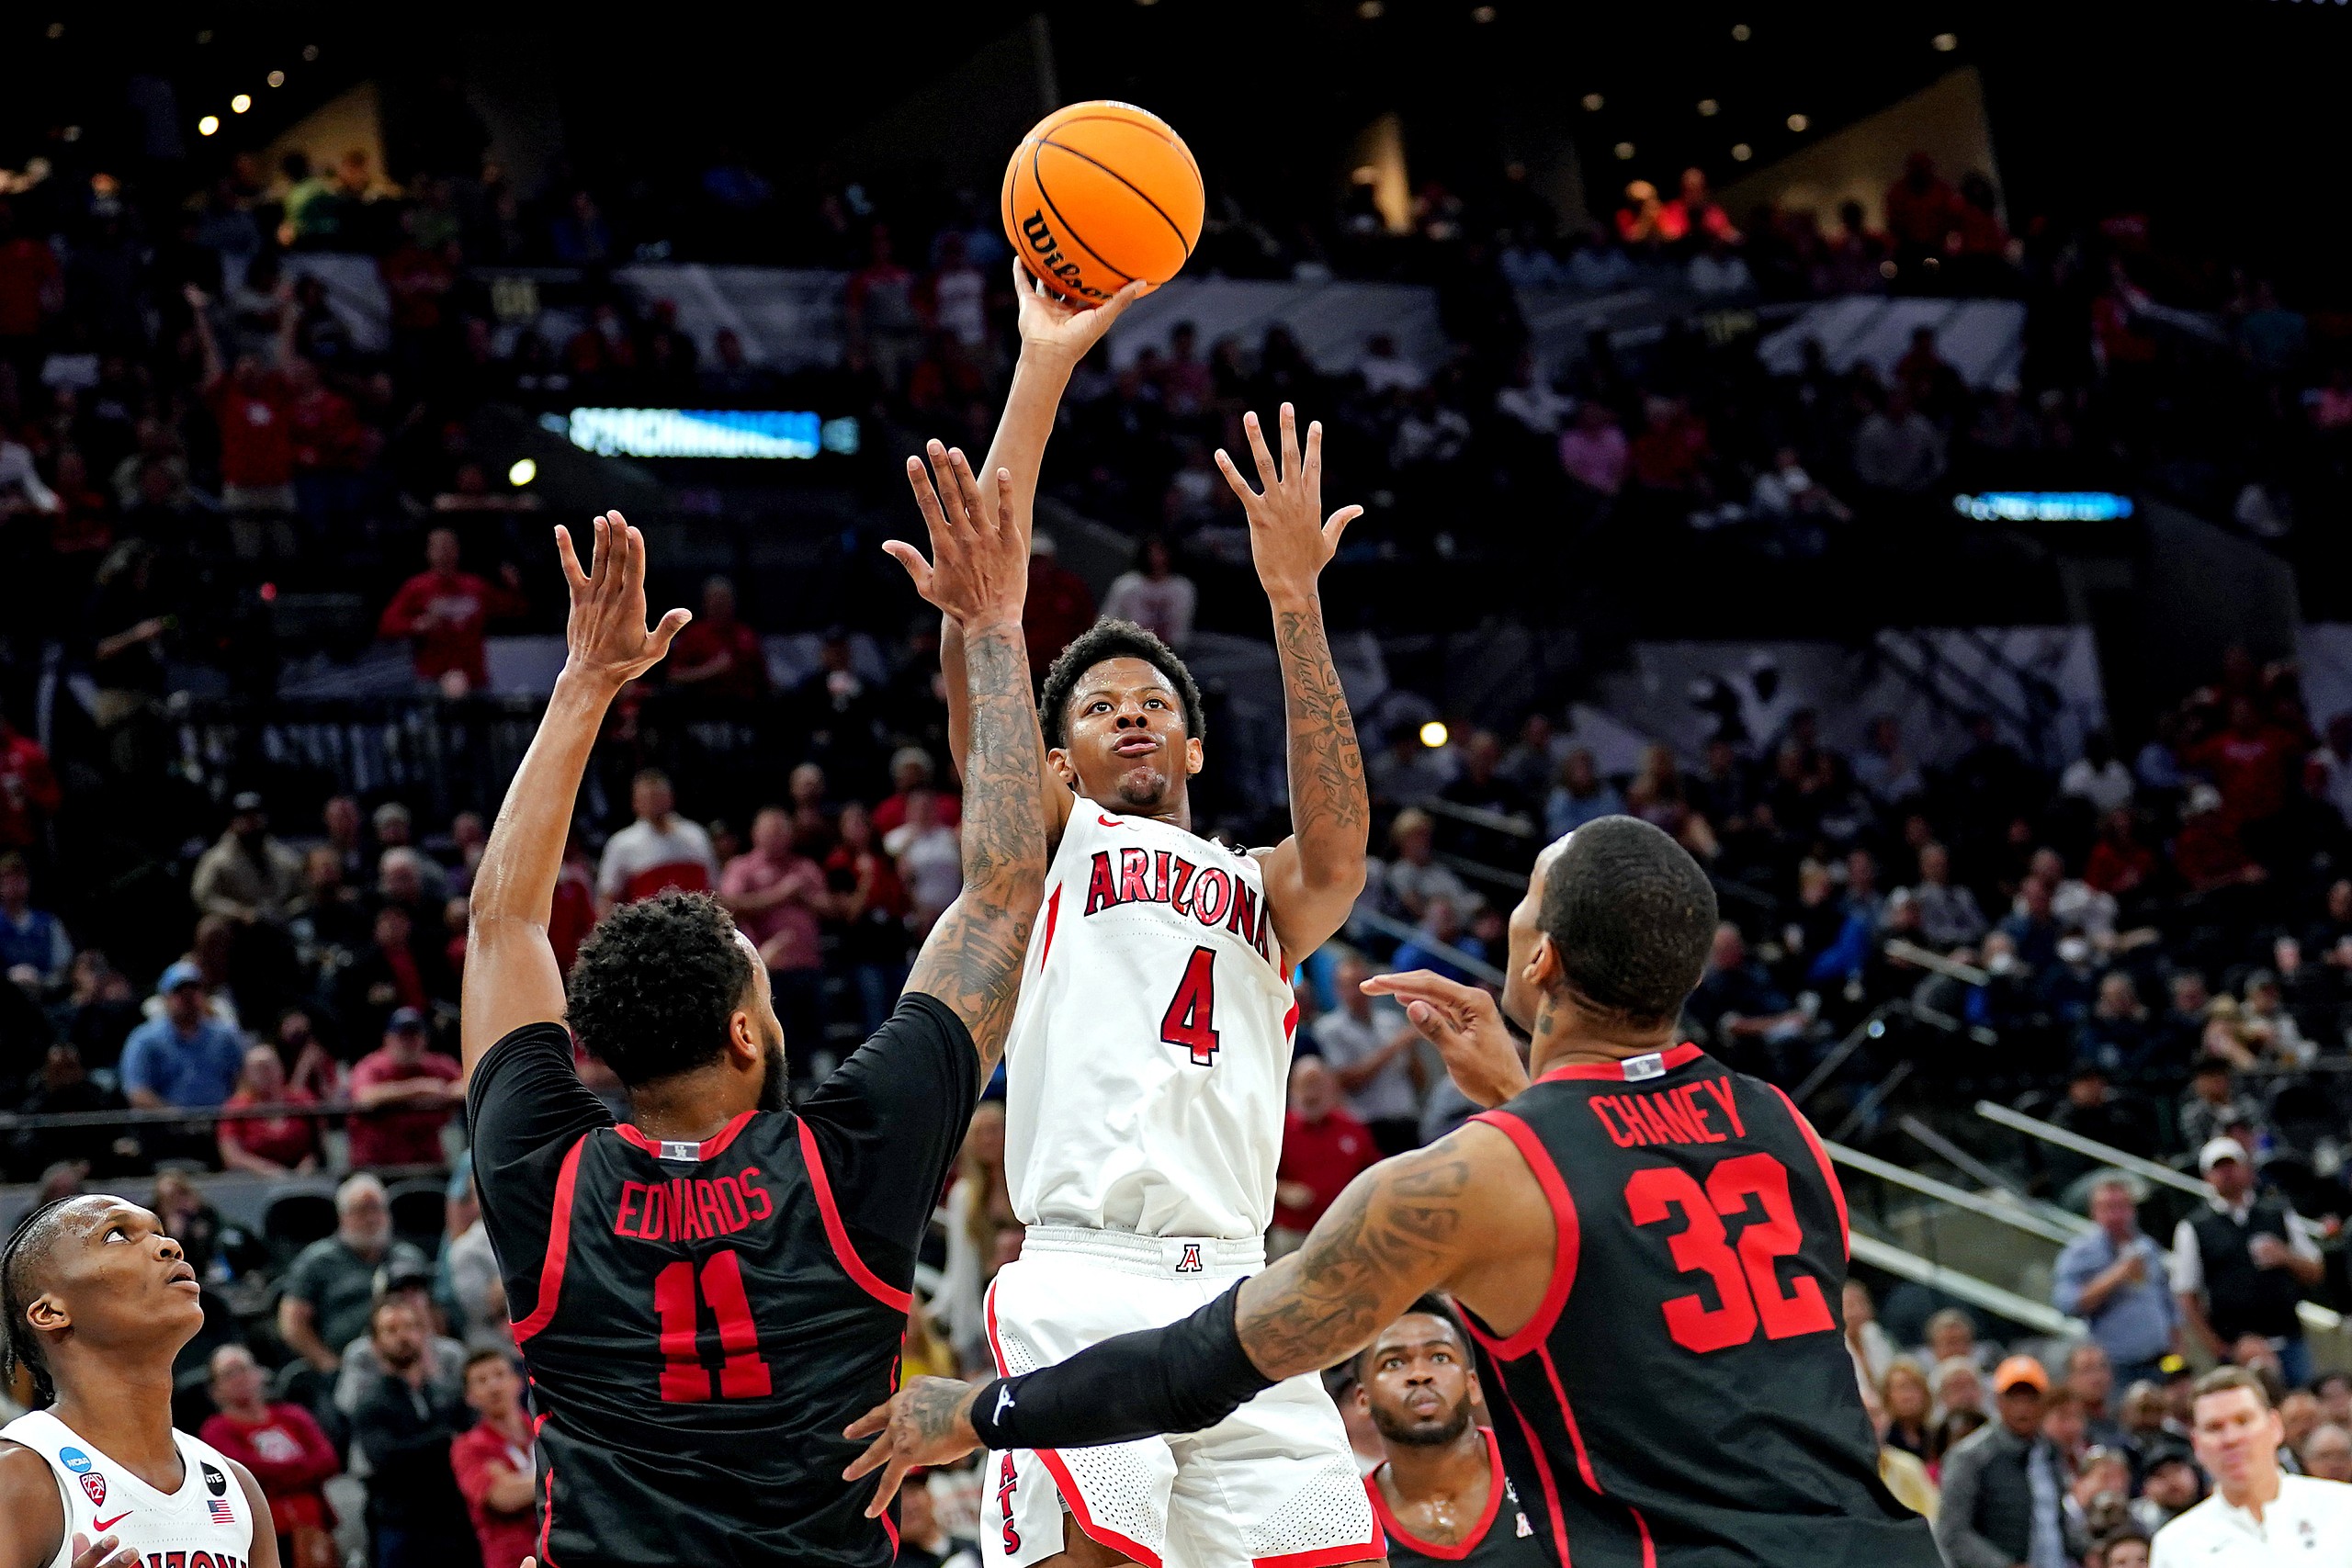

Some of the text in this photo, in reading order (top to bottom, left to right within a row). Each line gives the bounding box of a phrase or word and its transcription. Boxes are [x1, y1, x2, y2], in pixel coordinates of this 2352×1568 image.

[1283, 626, 1329, 726] Judge
[1084, 847, 1271, 965] ARIZONA
[1160, 945, 1219, 1066] 4
[1589, 1076, 1746, 1148] CHANEY
[614, 1167, 774, 1243] EDWARDS
[1623, 1152, 1836, 1354] 32
[1175, 1244, 1203, 1272] A
[654, 1249, 773, 1403] 11
[82, 1473, 105, 1493] PAC
[89, 1485, 104, 1500] 12
[997, 1449, 1021, 1555] ATS
